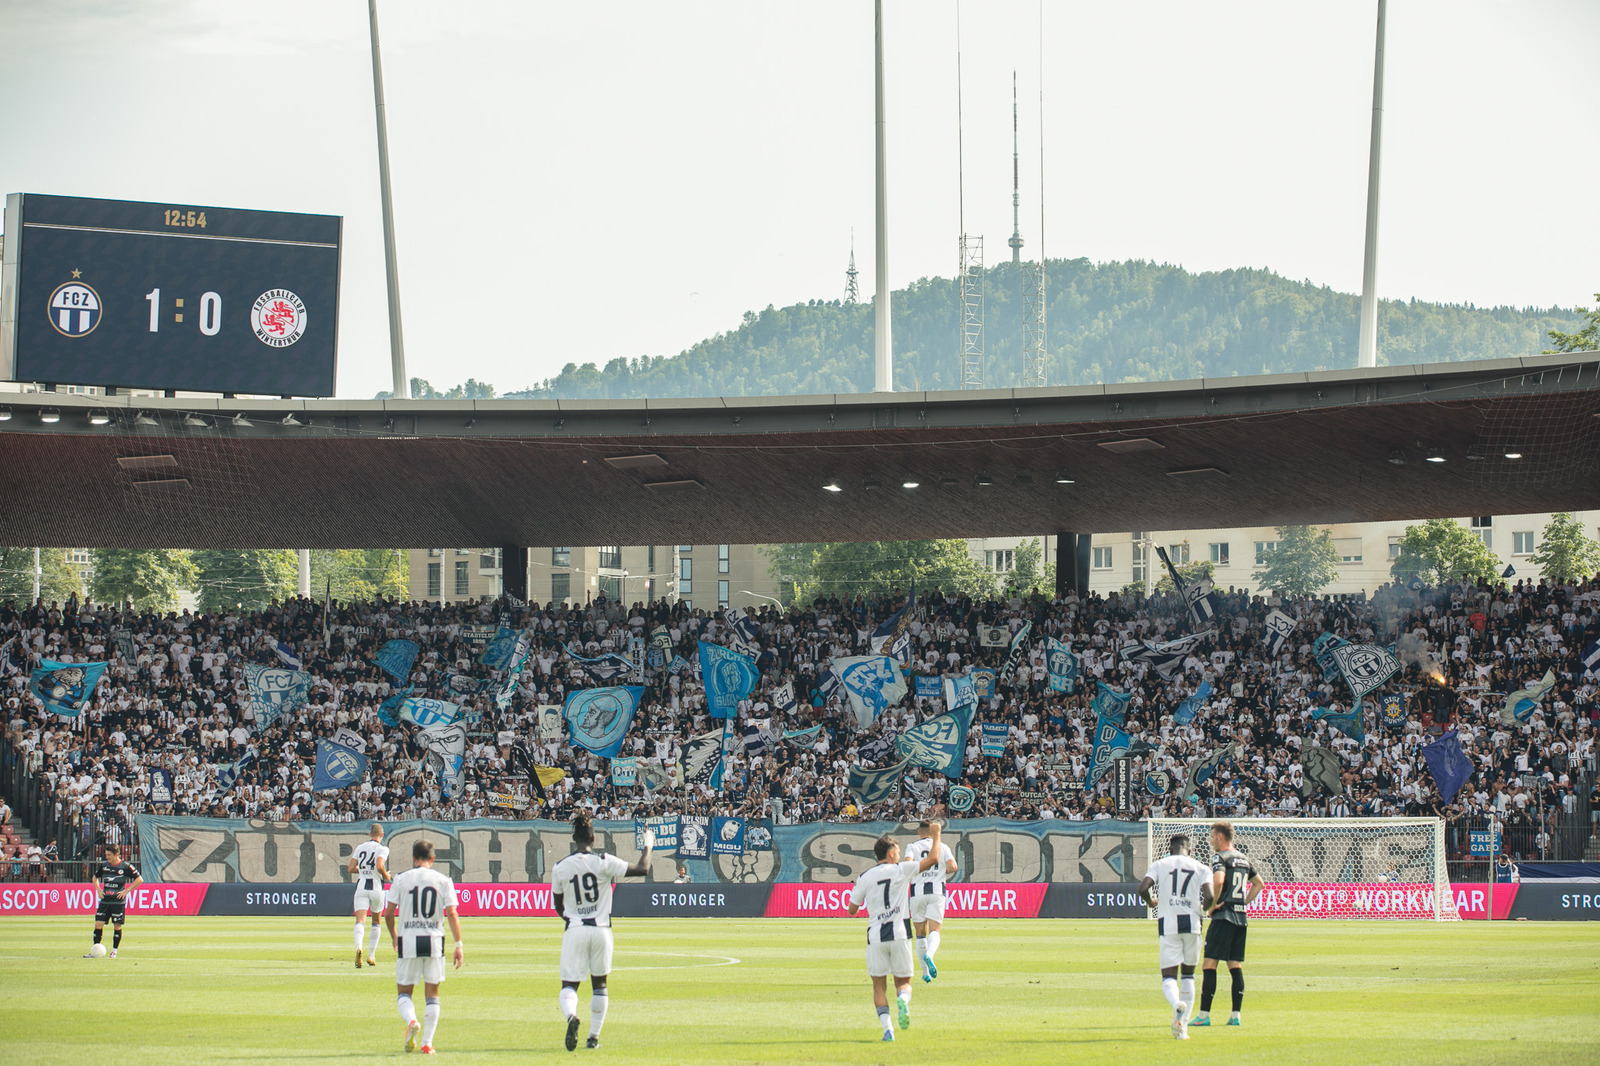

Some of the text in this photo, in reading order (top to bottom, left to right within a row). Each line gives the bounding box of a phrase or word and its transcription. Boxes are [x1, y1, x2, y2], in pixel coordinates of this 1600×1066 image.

[164, 209, 207, 228] 12:54
[63, 291, 89, 306] FCZ
[253, 290, 306, 314] FUSSBALLCLUB
[256, 328, 301, 347] WINTERTHUR
[1352, 654, 1370, 666] FCZ
[264, 673, 297, 690] FCZ
[846, 660, 894, 689] FCZ
[1347, 654, 1399, 698] BRIGATA
[338, 733, 362, 752] FCZ
[340, 754, 357, 772] FCZ
[659, 823, 677, 836] DU
[681, 814, 709, 827] NELSON
[713, 842, 742, 851] MIGU
[1470, 834, 1498, 842] FREE
[359, 851, 376, 871] 24
[569, 872, 600, 906] 19
[1169, 868, 1195, 898] 17
[0, 888, 179, 911] SCOT® WOWEAR
[246, 892, 318, 905] STRONGER
[408, 885, 438, 919] 10
[476, 889, 557, 911] WORKW
[651, 893, 726, 906] STRONGER
[877, 878, 891, 910] 7
[945, 889, 1018, 911] KWEAR
[1087, 893, 1148, 907] STRONG
[1354, 889, 1486, 913] WORKWEAR
